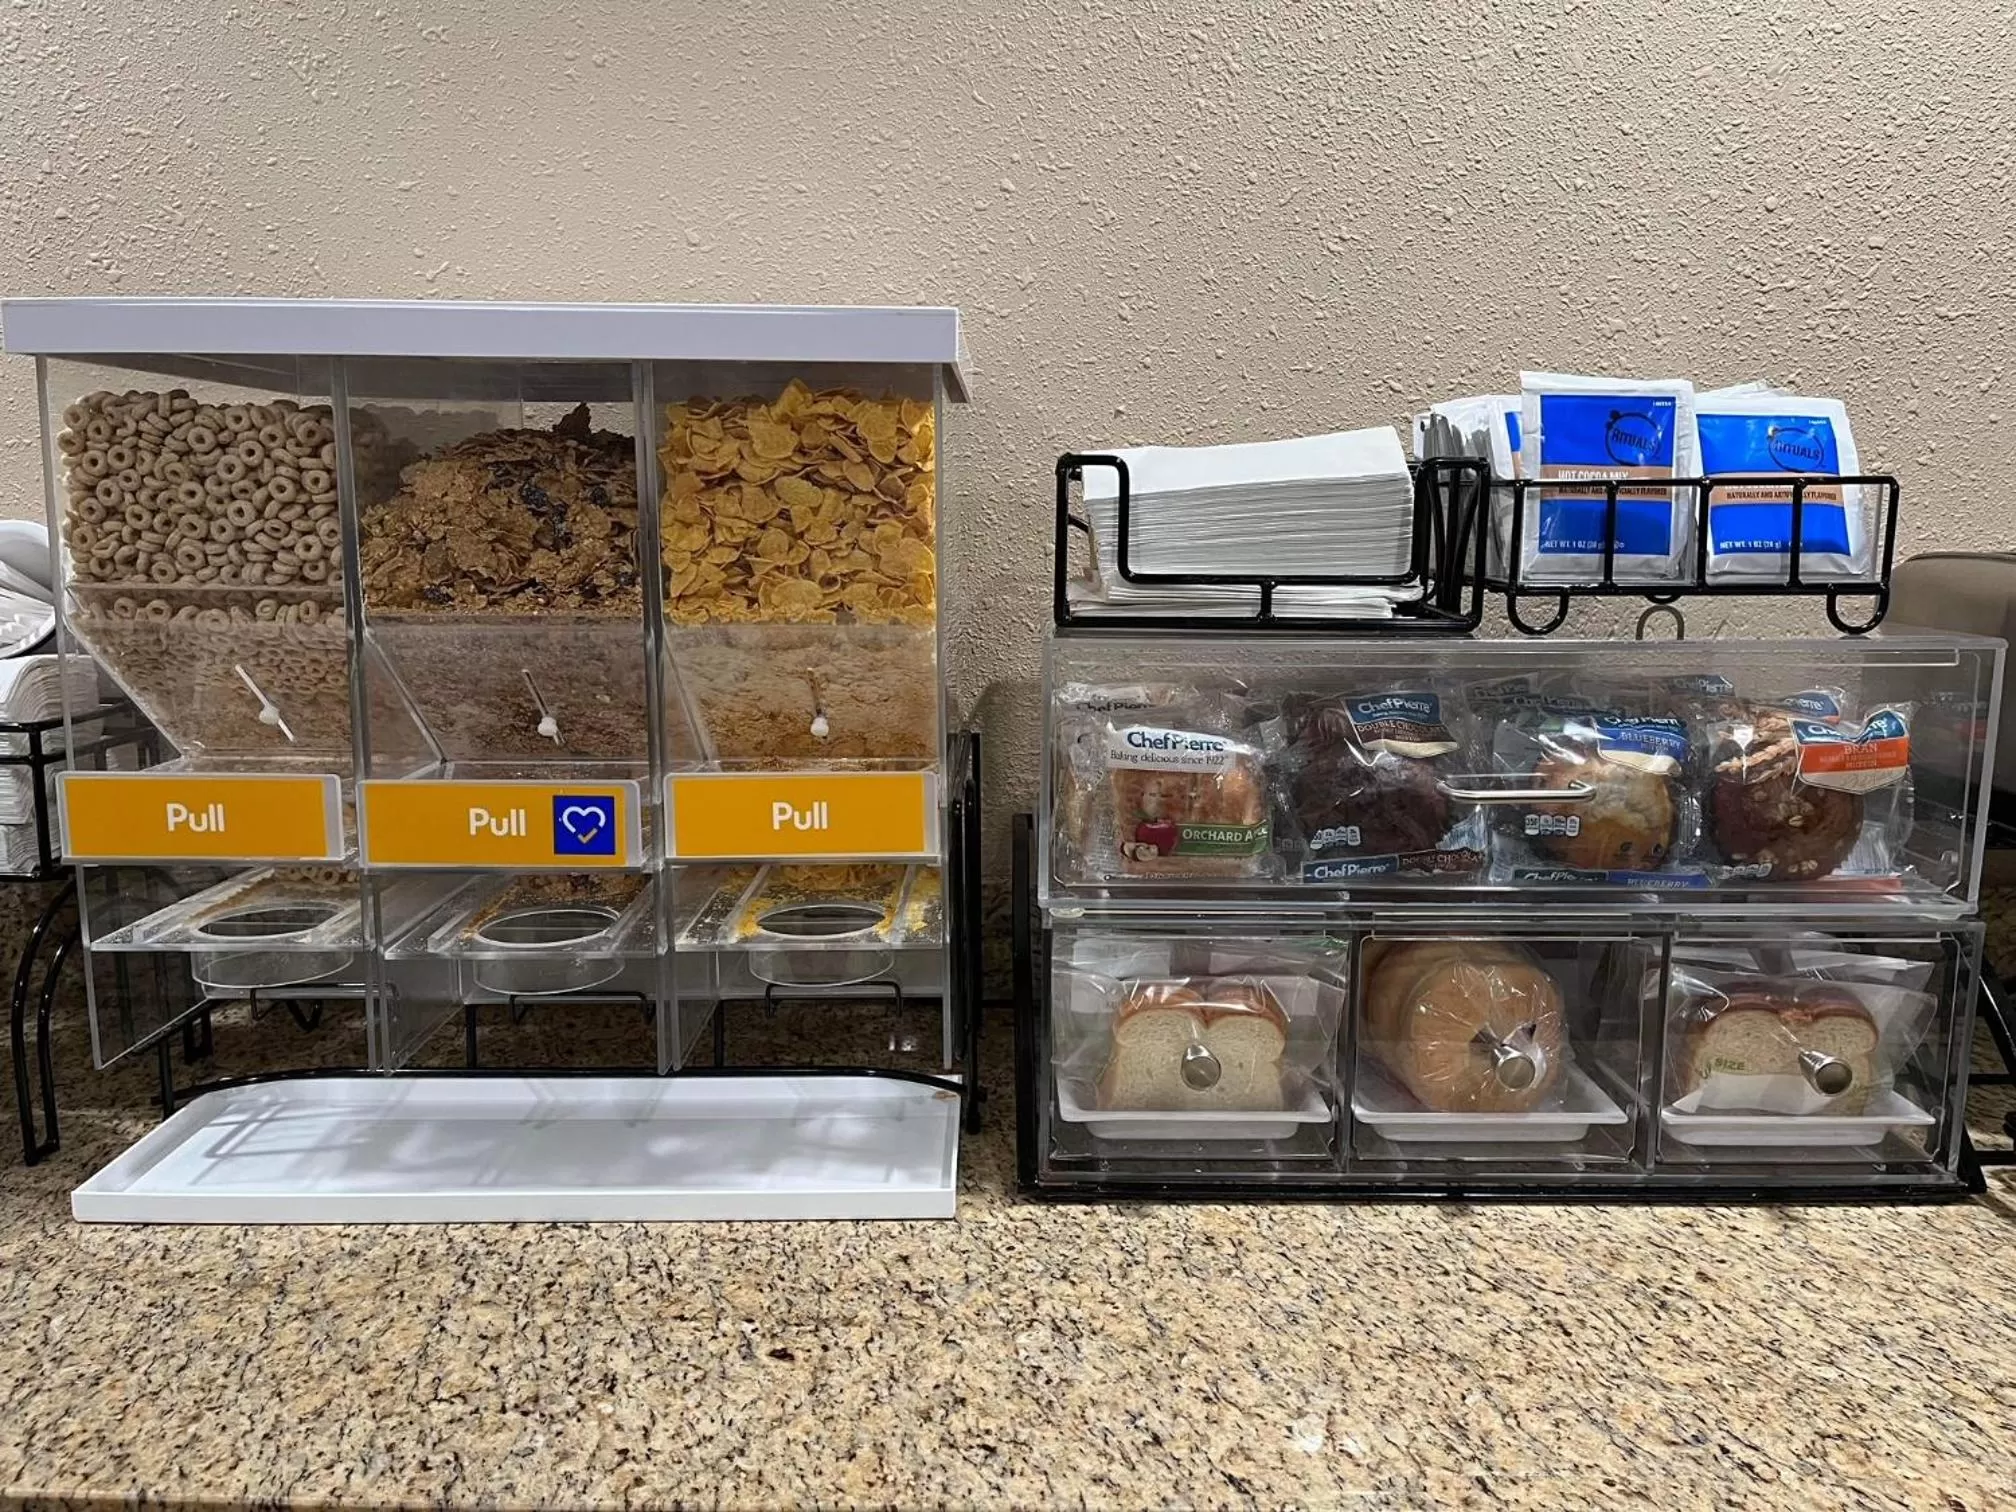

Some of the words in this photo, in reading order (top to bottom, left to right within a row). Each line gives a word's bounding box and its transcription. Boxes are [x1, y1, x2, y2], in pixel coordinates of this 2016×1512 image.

[1611, 428, 1656, 452] RITUALS
[1772, 440, 1820, 460] RITUALS
[1621, 731, 1681, 750] BLUEBERRY
[1843, 743, 1878, 754] BRAN
[1111, 750, 1138, 763] Baking
[1140, 753, 1179, 763] delicious
[1181, 755, 1204, 764] since
[167, 803, 224, 831] Pull
[469, 808, 525, 836] Pull
[772, 802, 828, 830] Pull
[1182, 828, 1242, 842] ORCHARD
[1714, 1058, 1744, 1071] SIZE
